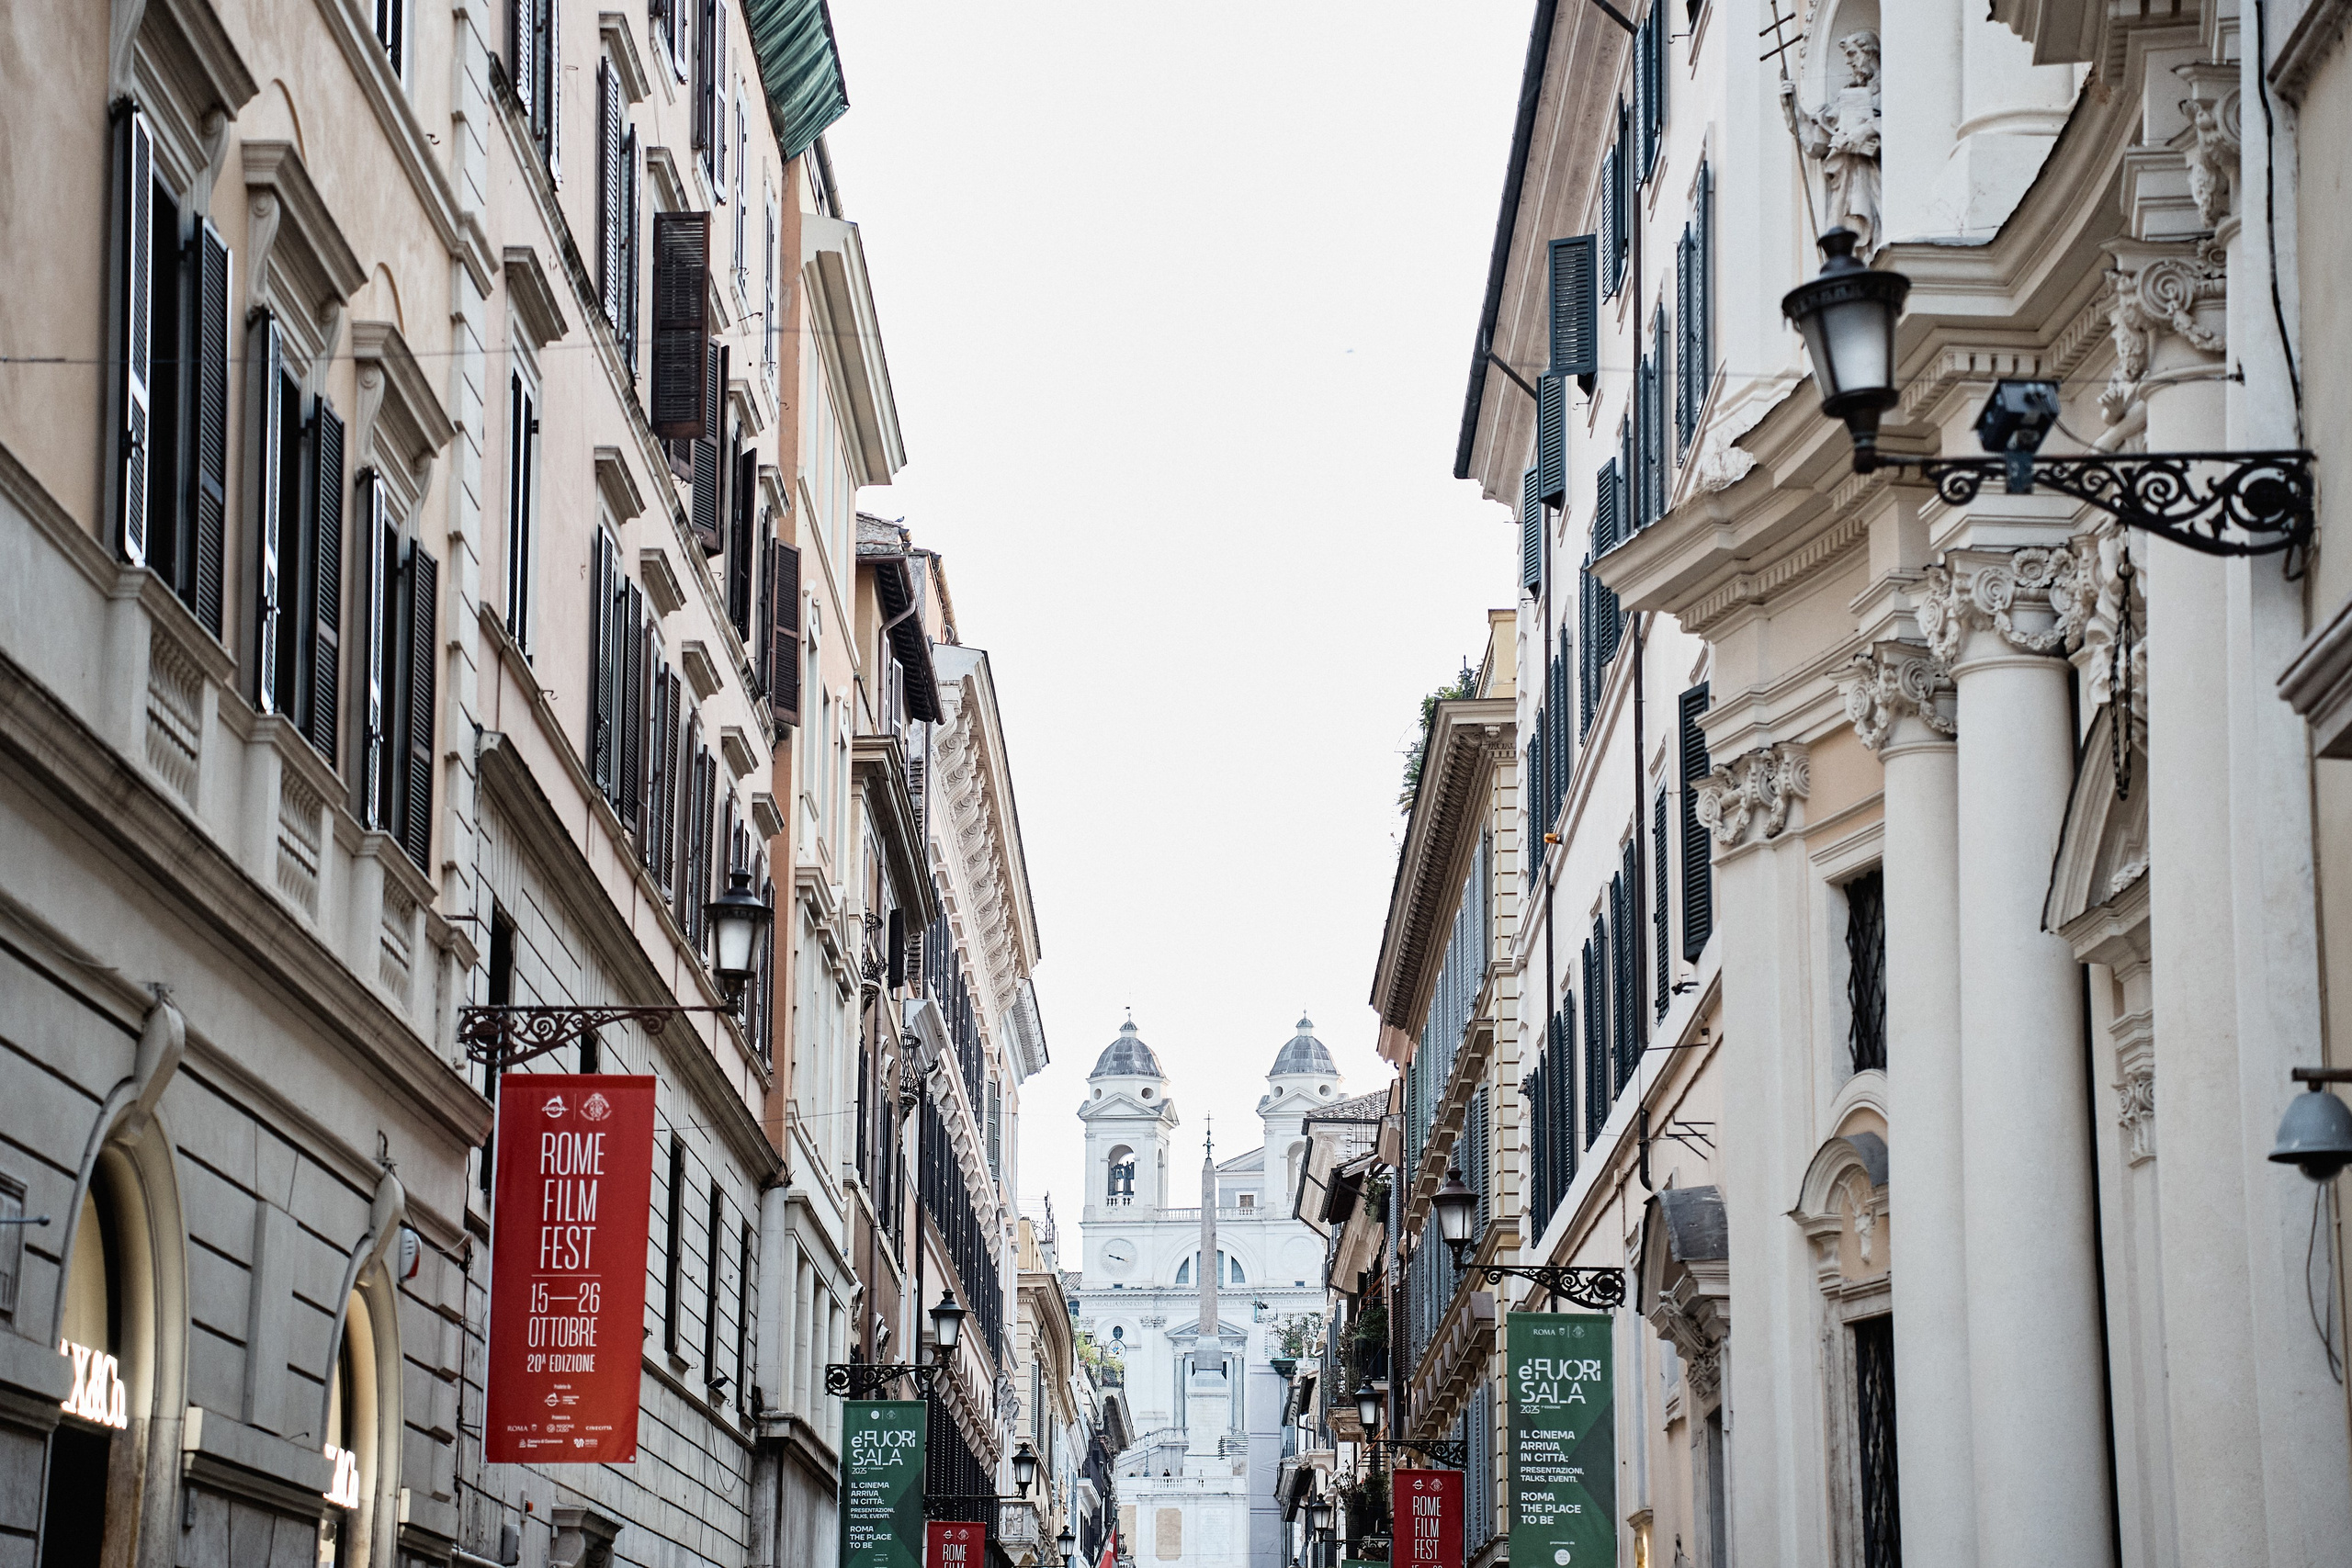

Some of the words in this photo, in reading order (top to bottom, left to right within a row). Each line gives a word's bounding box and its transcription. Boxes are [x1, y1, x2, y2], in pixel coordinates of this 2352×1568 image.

[541, 1132, 605, 1175] ROME
[544, 1179, 597, 1222] FILM
[540, 1225, 596, 1269] FEST
[528, 1316, 597, 1347] OTTOBRE
[549, 1354, 594, 1372] EDIZIONE
[1521, 1382, 1586, 1404] SALA
[1520, 1404, 1540, 1414] 2025
[1521, 1430, 1530, 1438] IL
[1532, 1430, 1575, 1439] CINEMA
[1521, 1442, 1560, 1451] ARRIVA
[853, 1449, 903, 1465] SALA
[1521, 1453, 1531, 1461] IN
[1534, 1451, 1568, 1462] CITTÀ:
[1521, 1467, 1584, 1476] PRESENTAZIONI,
[1521, 1493, 1555, 1501] ROMA
[1413, 1496, 1442, 1516] ROME
[1521, 1504, 1542, 1512] THE
[1545, 1505, 1581, 1513] PLACE
[1416, 1517, 1439, 1538] FILM
[1521, 1516, 1537, 1524] TO
[1540, 1516, 1554, 1524] BE
[943, 1544, 967, 1561] ROME
[1415, 1540, 1439, 1559] FEST
